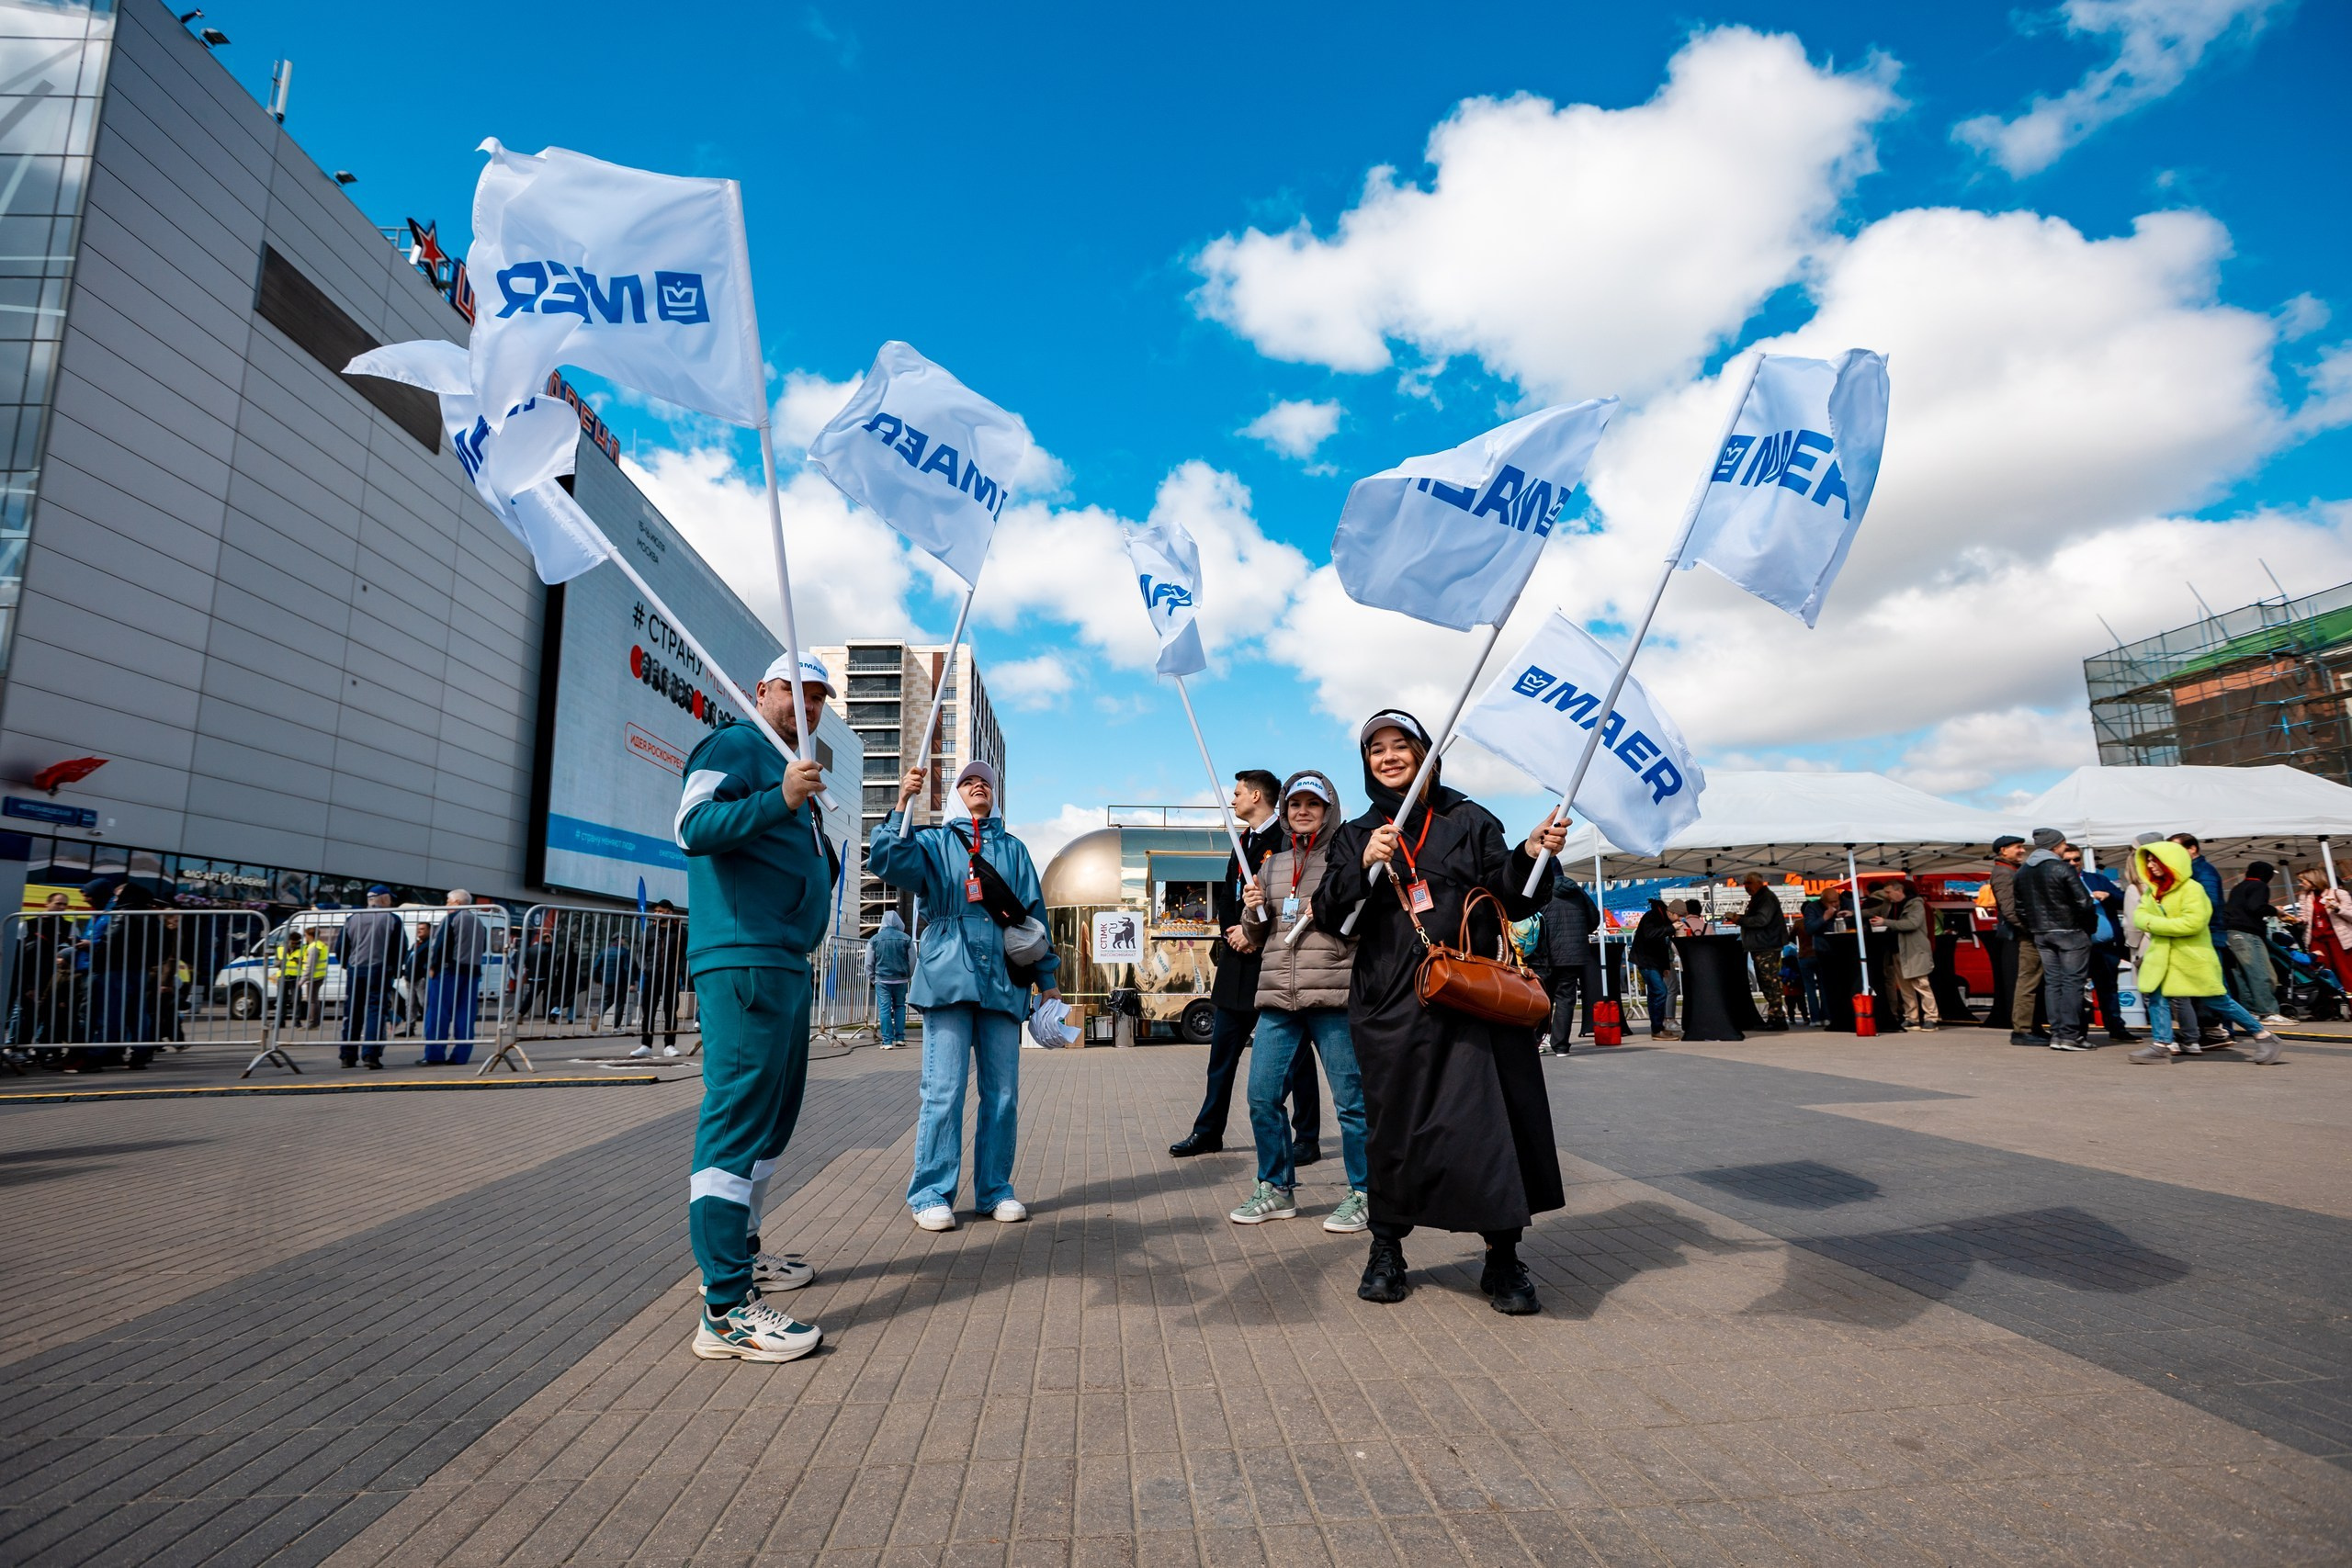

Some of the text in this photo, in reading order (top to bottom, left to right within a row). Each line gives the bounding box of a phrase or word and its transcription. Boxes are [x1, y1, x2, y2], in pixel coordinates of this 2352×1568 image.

[649, 614, 703, 676] СТРАНУ
[1541, 682, 1683, 806] MAER
[1100, 922, 1108, 950] СПМК
